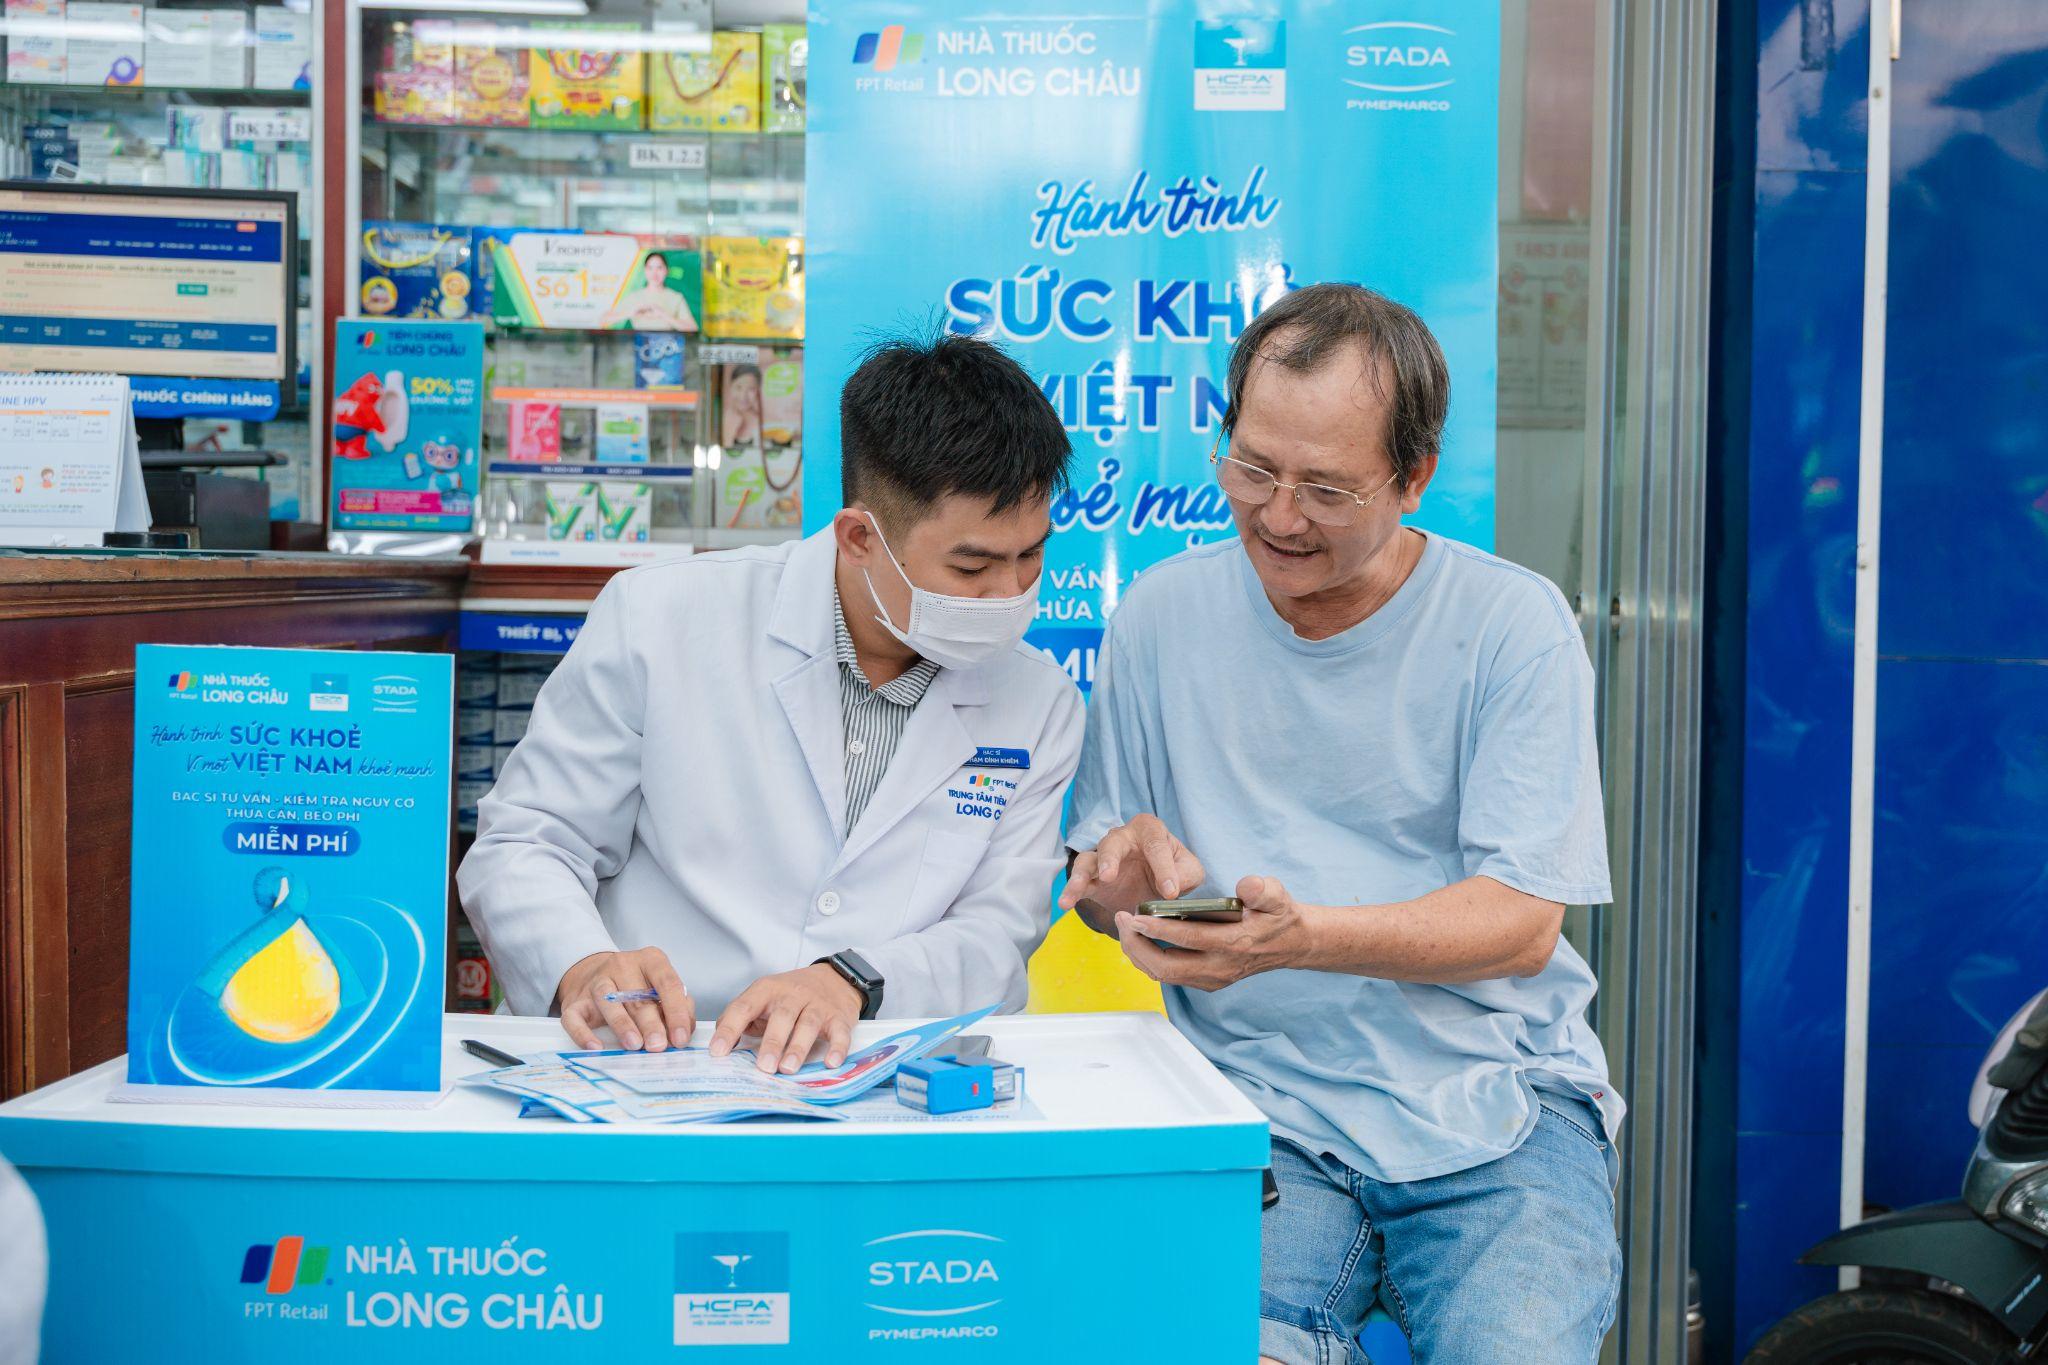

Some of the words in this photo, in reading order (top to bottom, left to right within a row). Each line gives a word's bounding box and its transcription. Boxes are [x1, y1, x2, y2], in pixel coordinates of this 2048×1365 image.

[937, 27, 995, 54] NHÀ
[1001, 22, 1097, 55] THUỐC
[1346, 46, 1450, 67] STADA
[856, 78, 881, 91] FPT
[885, 77, 925, 92] Retail
[937, 66, 1036, 97] LONG
[1044, 60, 1141, 97] CHÂU
[1346, 99, 1450, 111] PYMEPHARCO
[1163, 166, 1281, 236] trình
[946, 264, 1114, 341] SỨC
[1135, 263, 1301, 341] KH
[410, 377, 454, 395] 50%
[1050, 457, 1122, 527] oẻ
[1034, 595, 1094, 620] HỪA
[203, 673, 228, 686] NHÀ
[230, 672, 271, 687] THUỐC
[373, 685, 418, 695] STADA
[202, 690, 245, 703] LONG
[247, 688, 289, 705] CHÂU
[229, 719, 281, 746] SỨC
[289, 723, 362, 749] KHOẺ
[230, 747, 287, 778] VIỆT
[294, 754, 353, 775] NAM
[322, 796, 348, 807] TRA
[352, 797, 391, 808] NGUY
[948, 789, 974, 800] TRUNG
[976, 791, 993, 804] TÂM
[956, 802, 992, 819] LONG
[237, 825, 299, 852] MIỄN
[306, 830, 348, 852] PHÍ
[345, 1238, 417, 1275] NHÀ
[427, 1234, 548, 1277] THUỐC
[868, 1259, 999, 1286] STADA
[244, 1302, 275, 1318] FPT
[279, 1301, 328, 1320] Retail
[345, 1290, 470, 1328] LONG
[481, 1283, 604, 1330] CHÂU
[689, 1299, 771, 1312] HCPA
[868, 1324, 999, 1340] PYMEPHARCO
